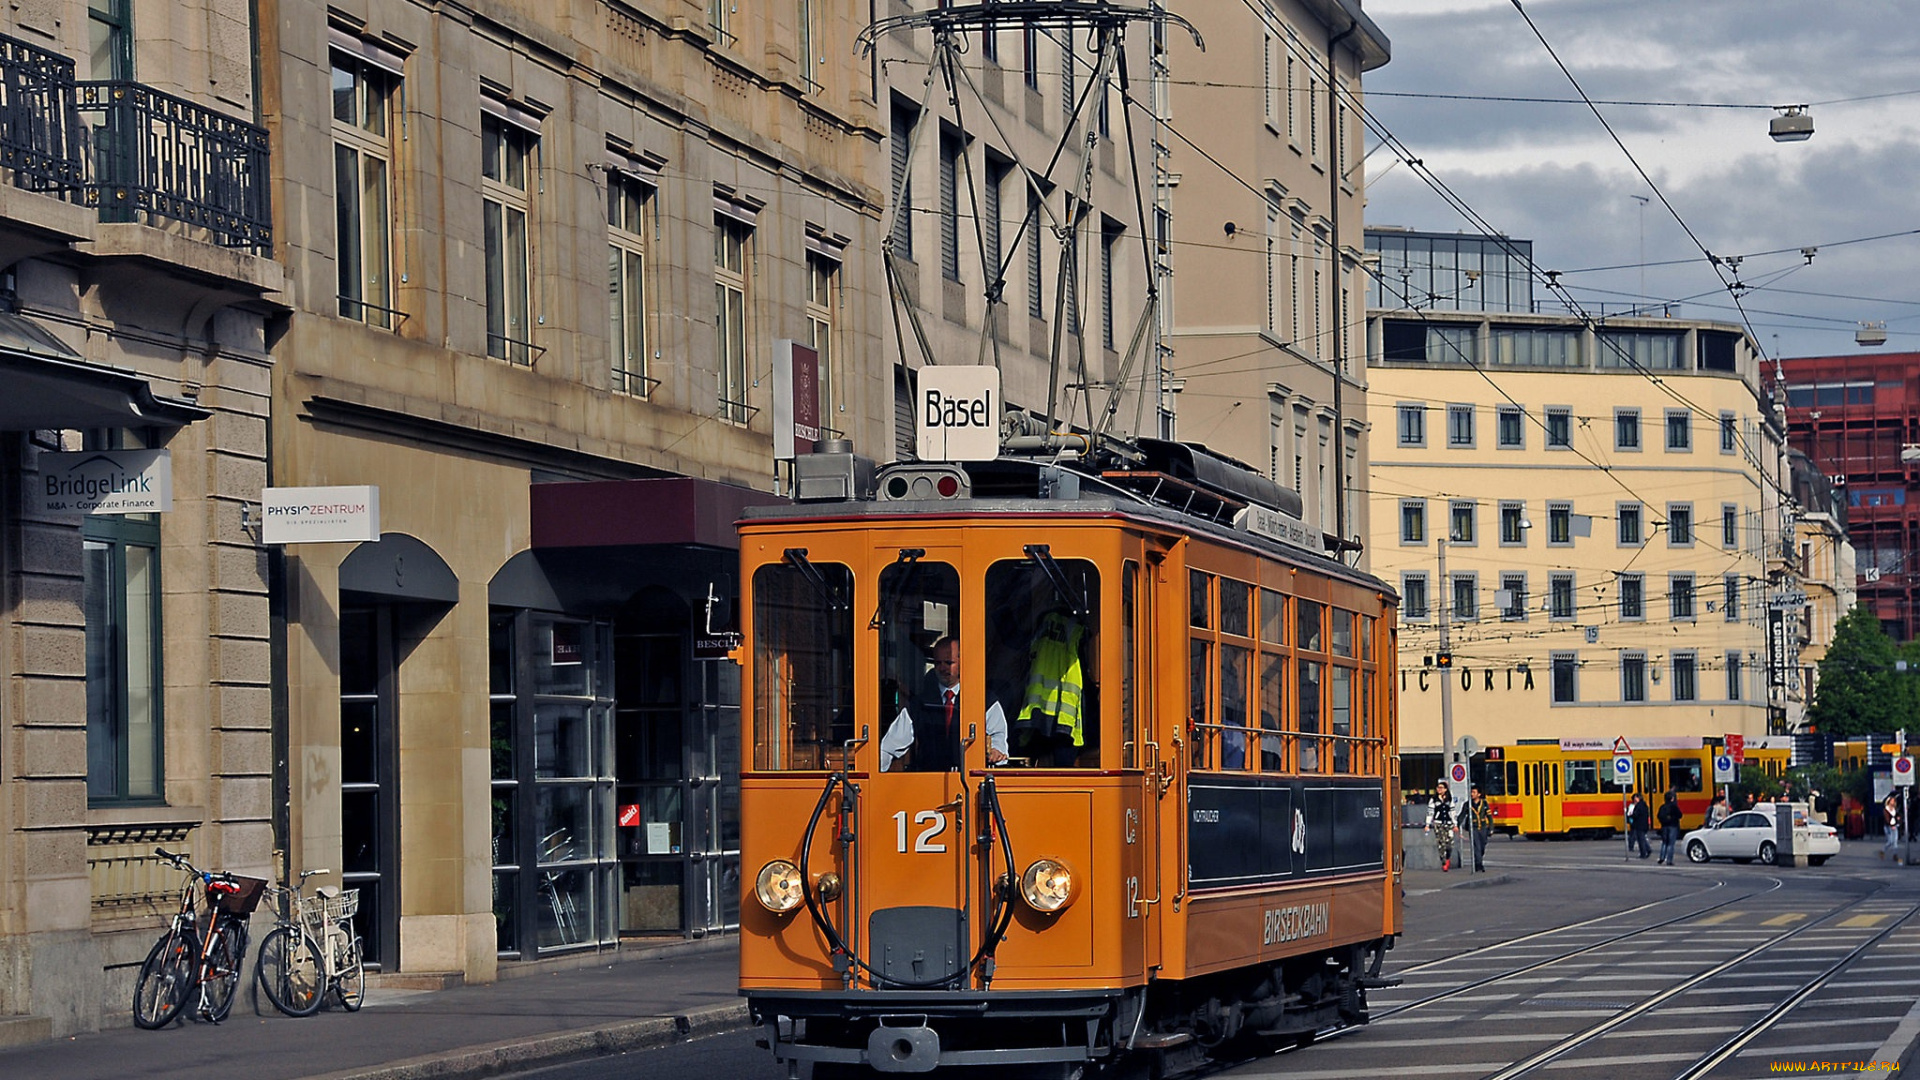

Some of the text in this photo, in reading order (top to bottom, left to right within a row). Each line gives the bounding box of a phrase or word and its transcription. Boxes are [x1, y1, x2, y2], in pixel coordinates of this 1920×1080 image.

[926, 389, 990, 427] Basel
[46, 472, 151, 500] BridgeLink
[47, 501, 67, 511] M&A
[76, 501, 119, 511] Corporate
[122, 499, 154, 508] Finance
[1588, 628, 1598, 638] 15
[1401, 667, 1535, 692] ICORIA
[1490, 749, 1499, 759] 11
[892, 811, 946, 853] 12
[1127, 876, 1138, 918] 12
[1264, 902, 1329, 945] BIRSECKBAHN
